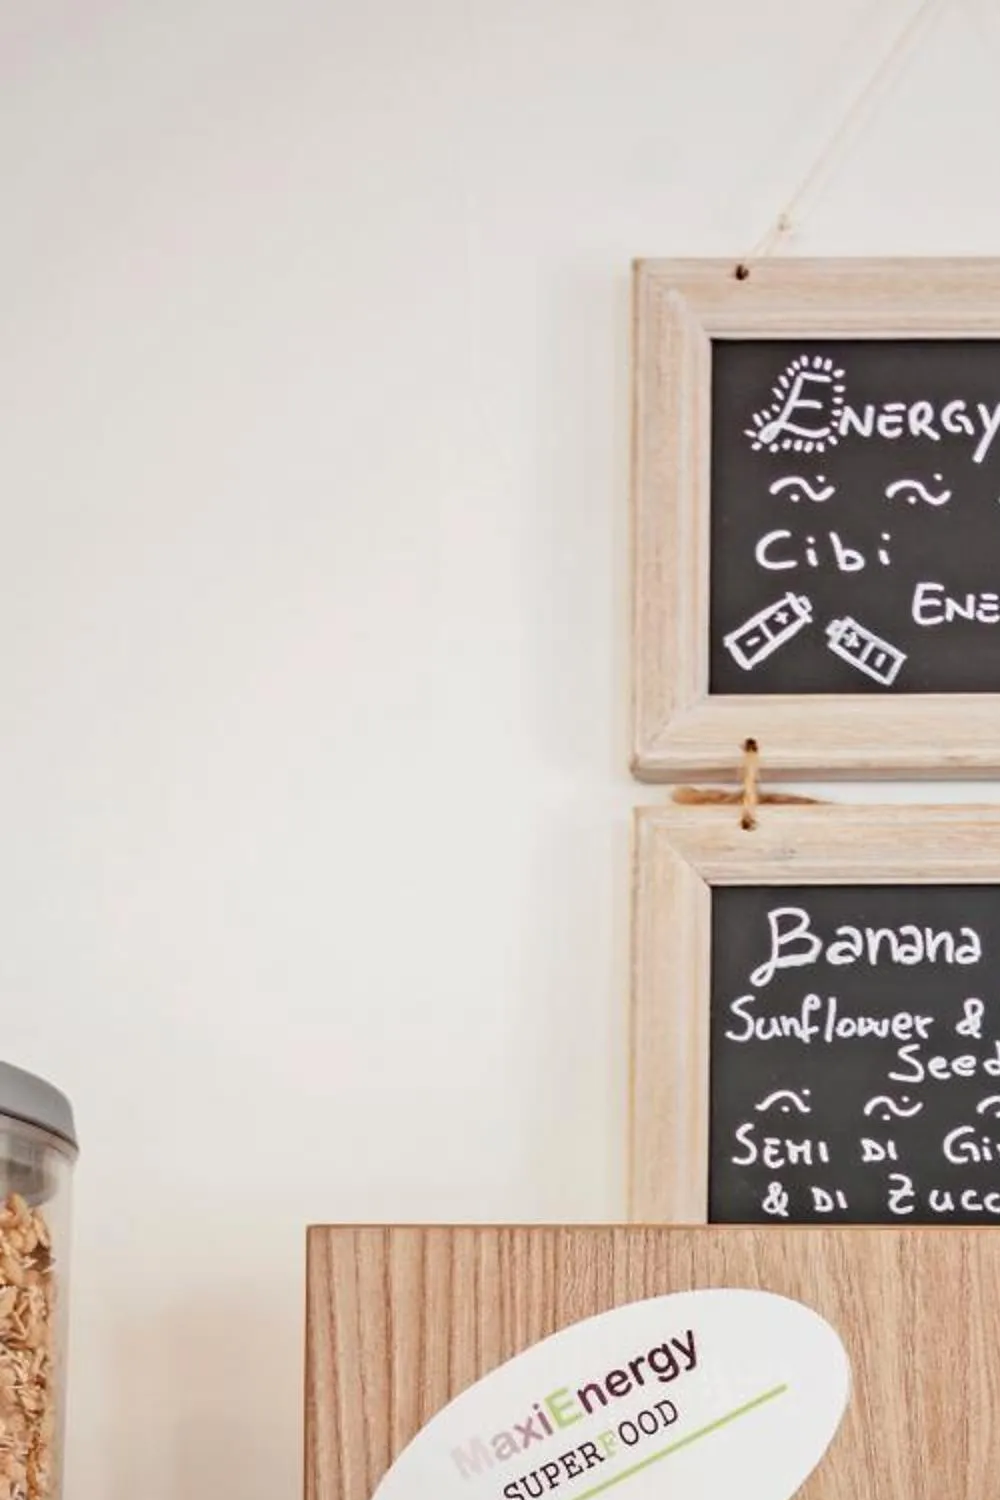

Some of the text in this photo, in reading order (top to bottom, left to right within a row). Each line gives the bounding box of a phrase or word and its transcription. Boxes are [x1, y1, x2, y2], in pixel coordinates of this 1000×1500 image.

[755, 529, 891, 571] Cibi
[750, 907, 982, 986] Banana
[725, 994, 934, 1044] Sunflower
[955, 997, 984, 1038] &
[731, 1124, 830, 1167] SEMI
[862, 1138, 898, 1162] DI
[762, 1181, 789, 1216] &
[813, 1187, 848, 1212] DI
[450, 1329, 699, 1480] MaxiEnergy
